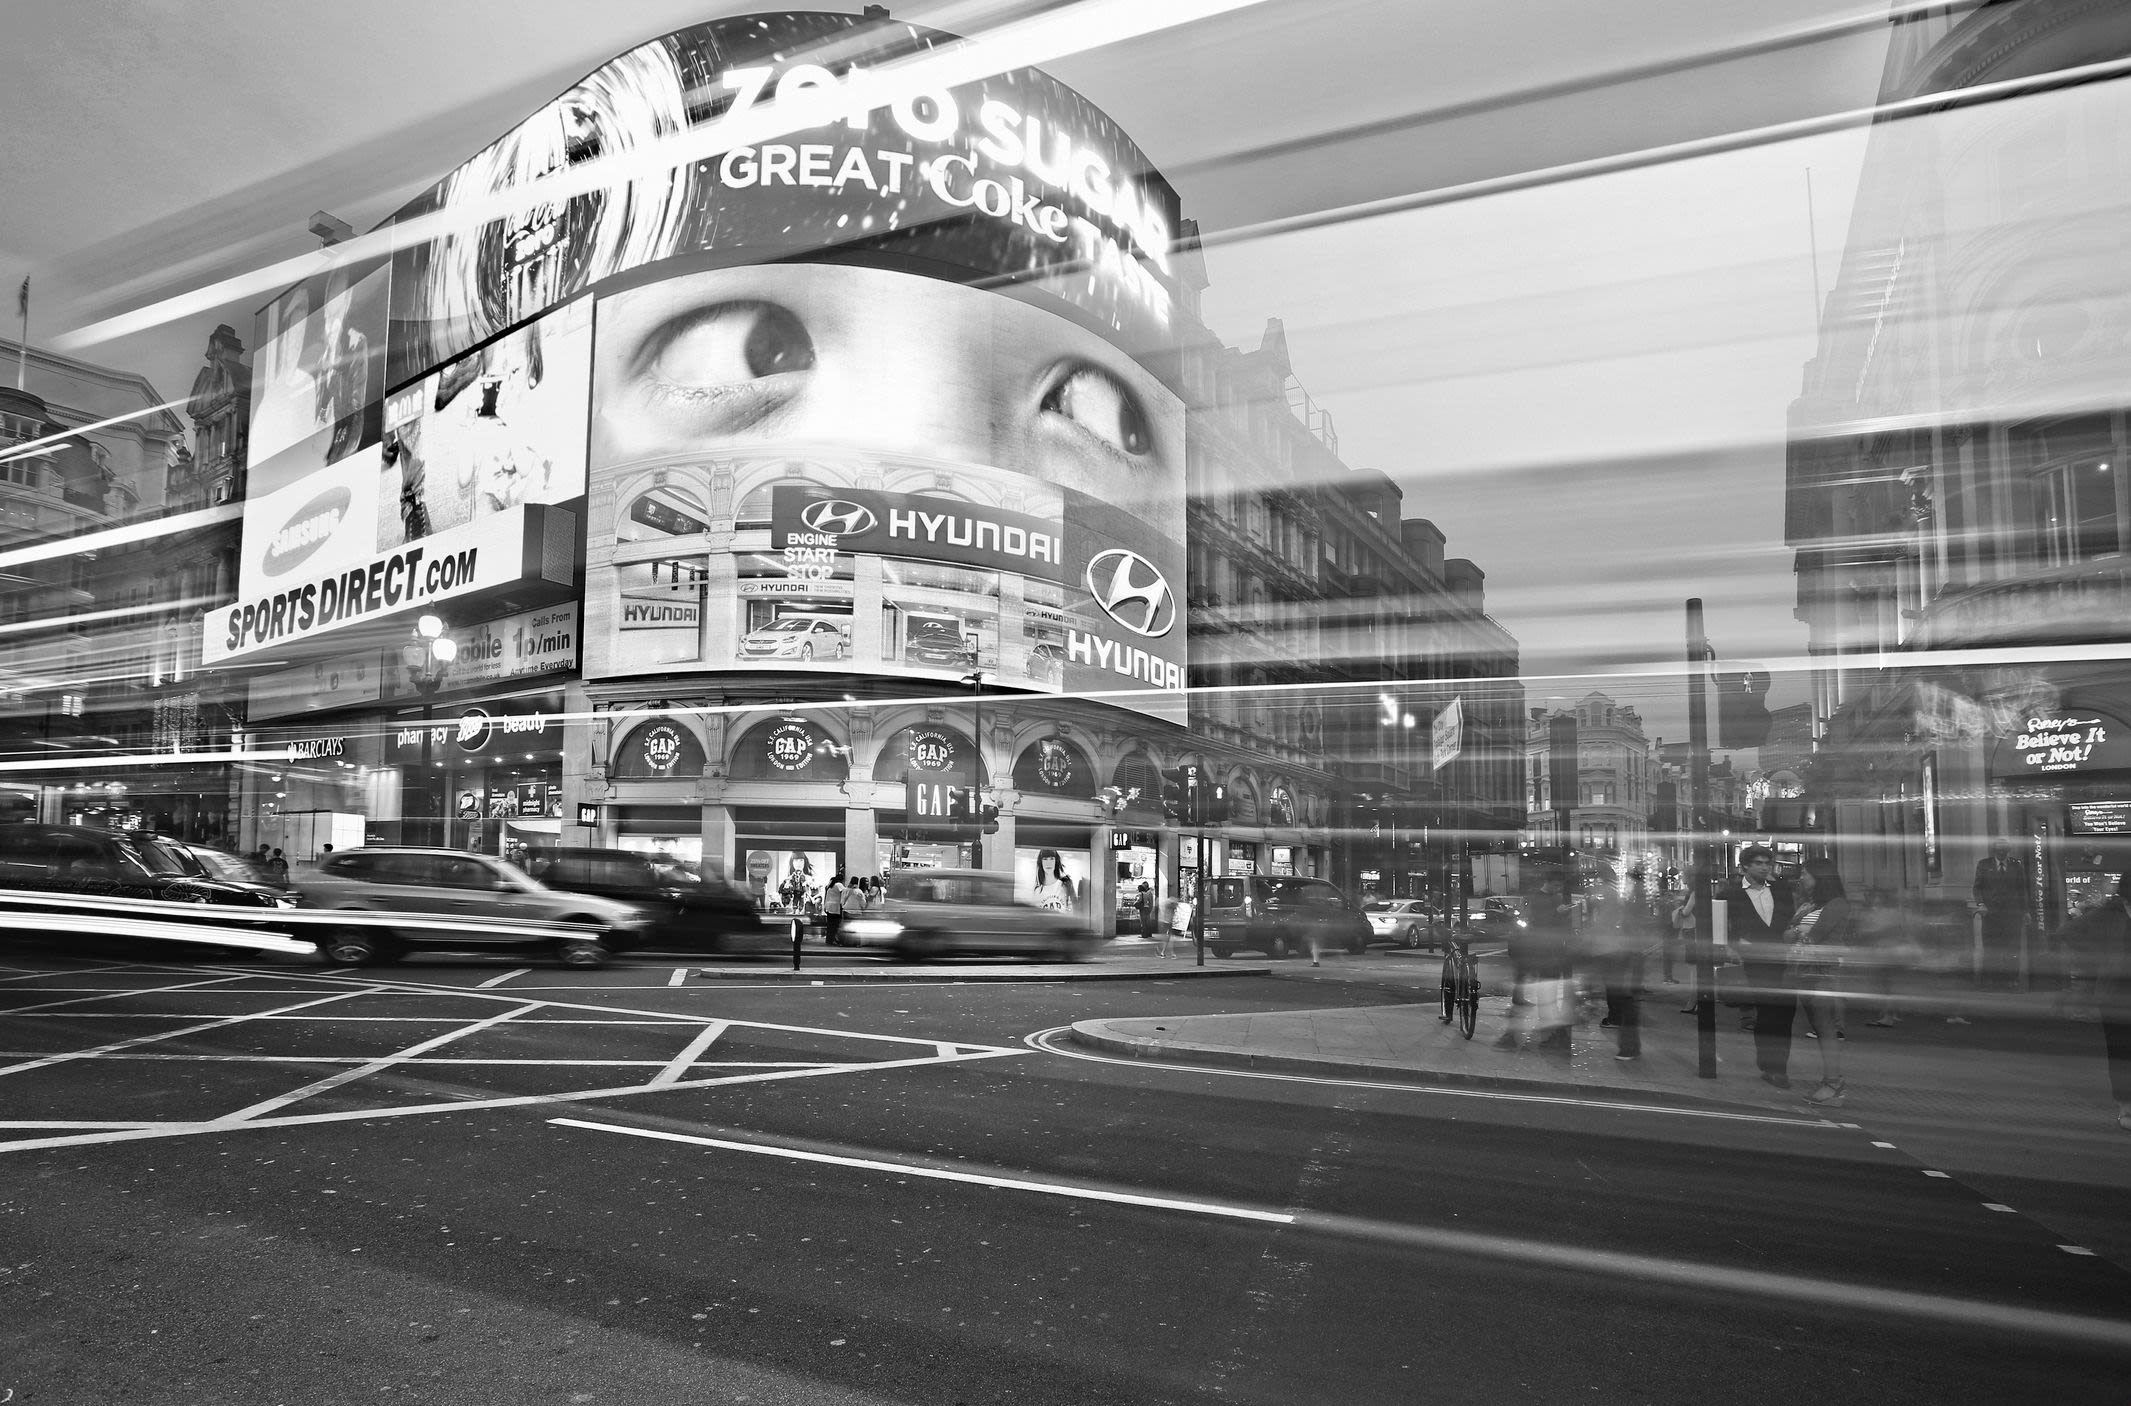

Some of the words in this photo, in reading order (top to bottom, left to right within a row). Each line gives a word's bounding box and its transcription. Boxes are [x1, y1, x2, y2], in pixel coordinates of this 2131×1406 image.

[977, 99, 1171, 277] SUGAR
[719, 144, 913, 193] GREAT
[926, 153, 1069, 243] Coke
[1073, 215, 1170, 324] TASTE
[271, 507, 340, 557] SAMSUNG
[787, 533, 838, 546] ENGINE
[889, 508, 1060, 565] HYUNDAI
[784, 547, 838, 564] START
[787, 564, 833, 580] STOP
[761, 584, 808, 592] HYUNDAI
[532, 618, 549, 628] Calls
[552, 612, 571, 623] From
[624, 604, 697, 622] HYUNDAI
[1041, 611, 1077, 625] HYUNDAI
[453, 633, 503, 664] obile
[541, 658, 574, 670] Everyday
[1068, 629, 1186, 695] HYUNDAI
[503, 711, 546, 734] beauty
[397, 724, 448, 748] pharacy
[2016, 732, 2081, 749] Believe
[2085, 727, 2106, 743] It
[297, 737, 345, 759] BARCLAYS
[650, 738, 676, 755] GAP
[775, 738, 807, 755] GAP
[917, 744, 948, 762] GAP
[2026, 752, 2046, 764] or
[2048, 744, 2092, 763] Not!
[780, 753, 800, 761] 1969
[922, 759, 941, 768] 1969
[1043, 756, 1067, 772] GAP
[2041, 763, 2076, 771] LONDON
[917, 783, 958, 816] GAP
[582, 808, 596, 823] GAP
[1113, 833, 1128, 847] GAP
[2034, 834, 2042, 860] Not!
[2037, 861, 2042, 874] or
[2083, 876, 2090, 884] of
